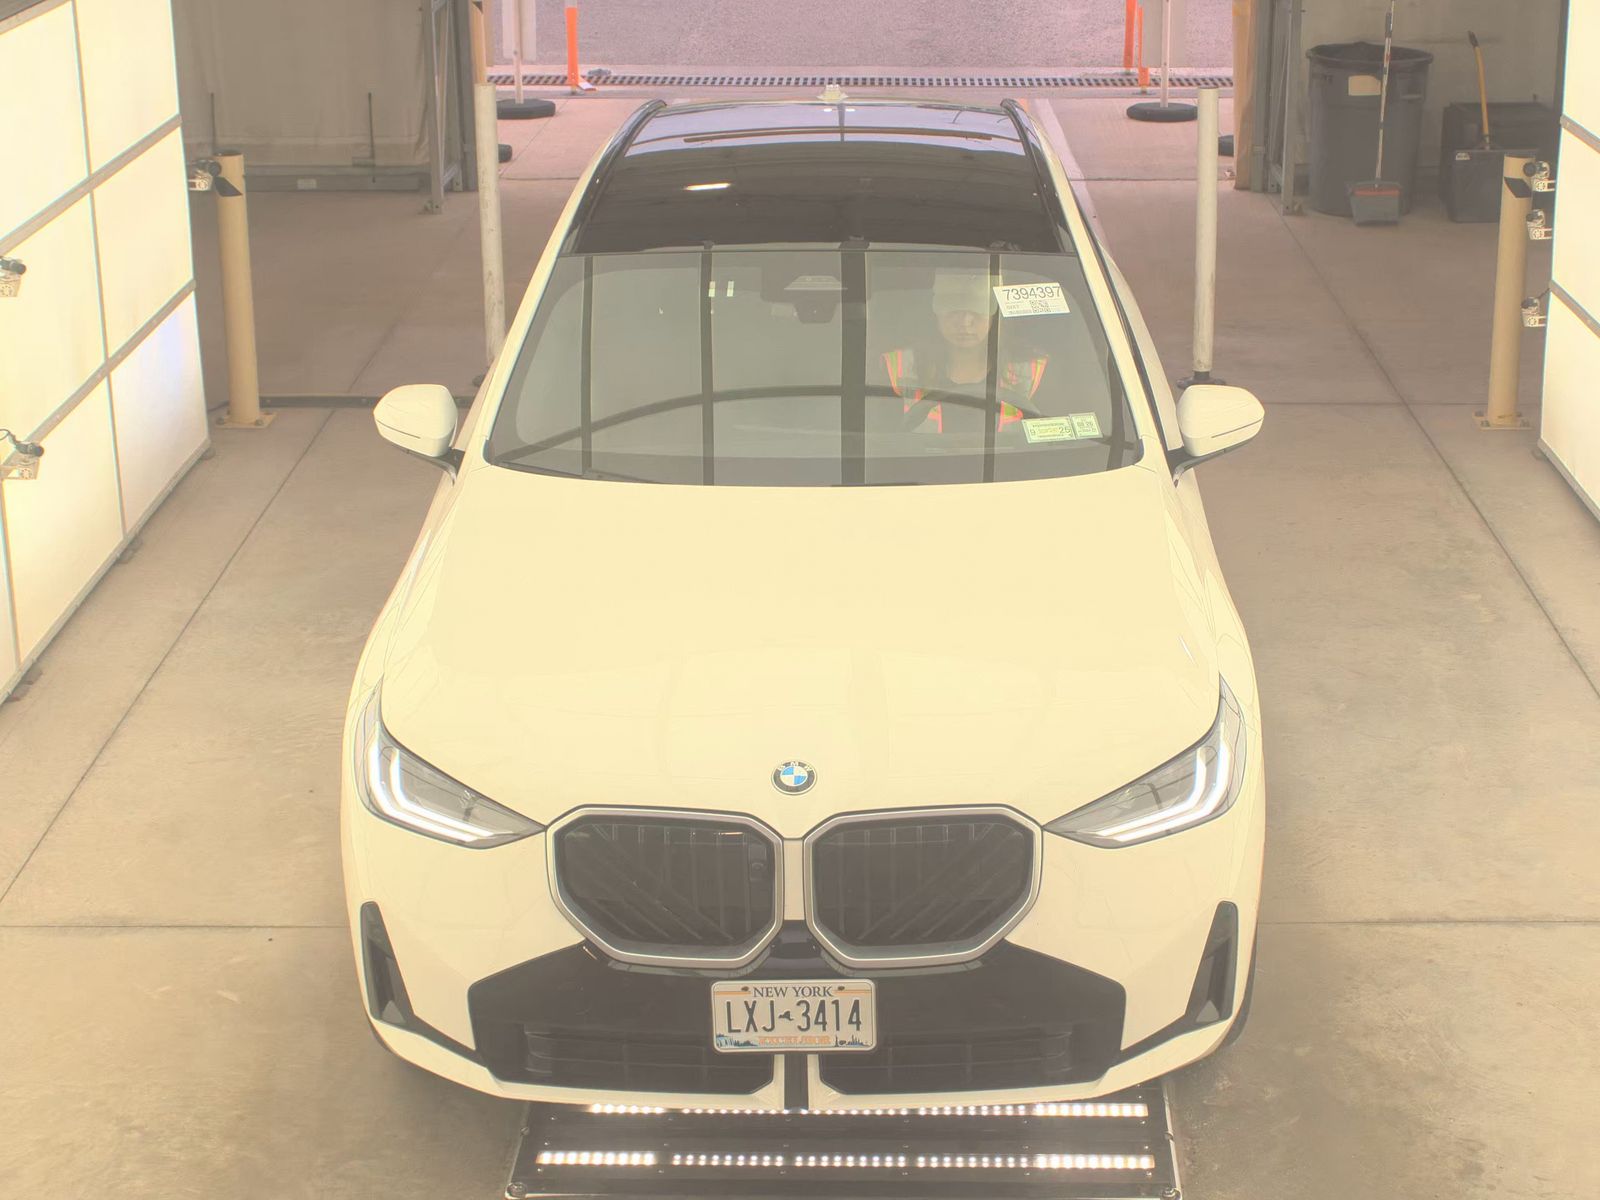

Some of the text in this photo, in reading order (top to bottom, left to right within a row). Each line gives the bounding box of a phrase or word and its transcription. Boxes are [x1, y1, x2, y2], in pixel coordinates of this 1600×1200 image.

[1002, 286, 1060, 301] 7394397
[753, 985, 834, 998] NEW YORK
[726, 999, 863, 1034] LXJ 3414
